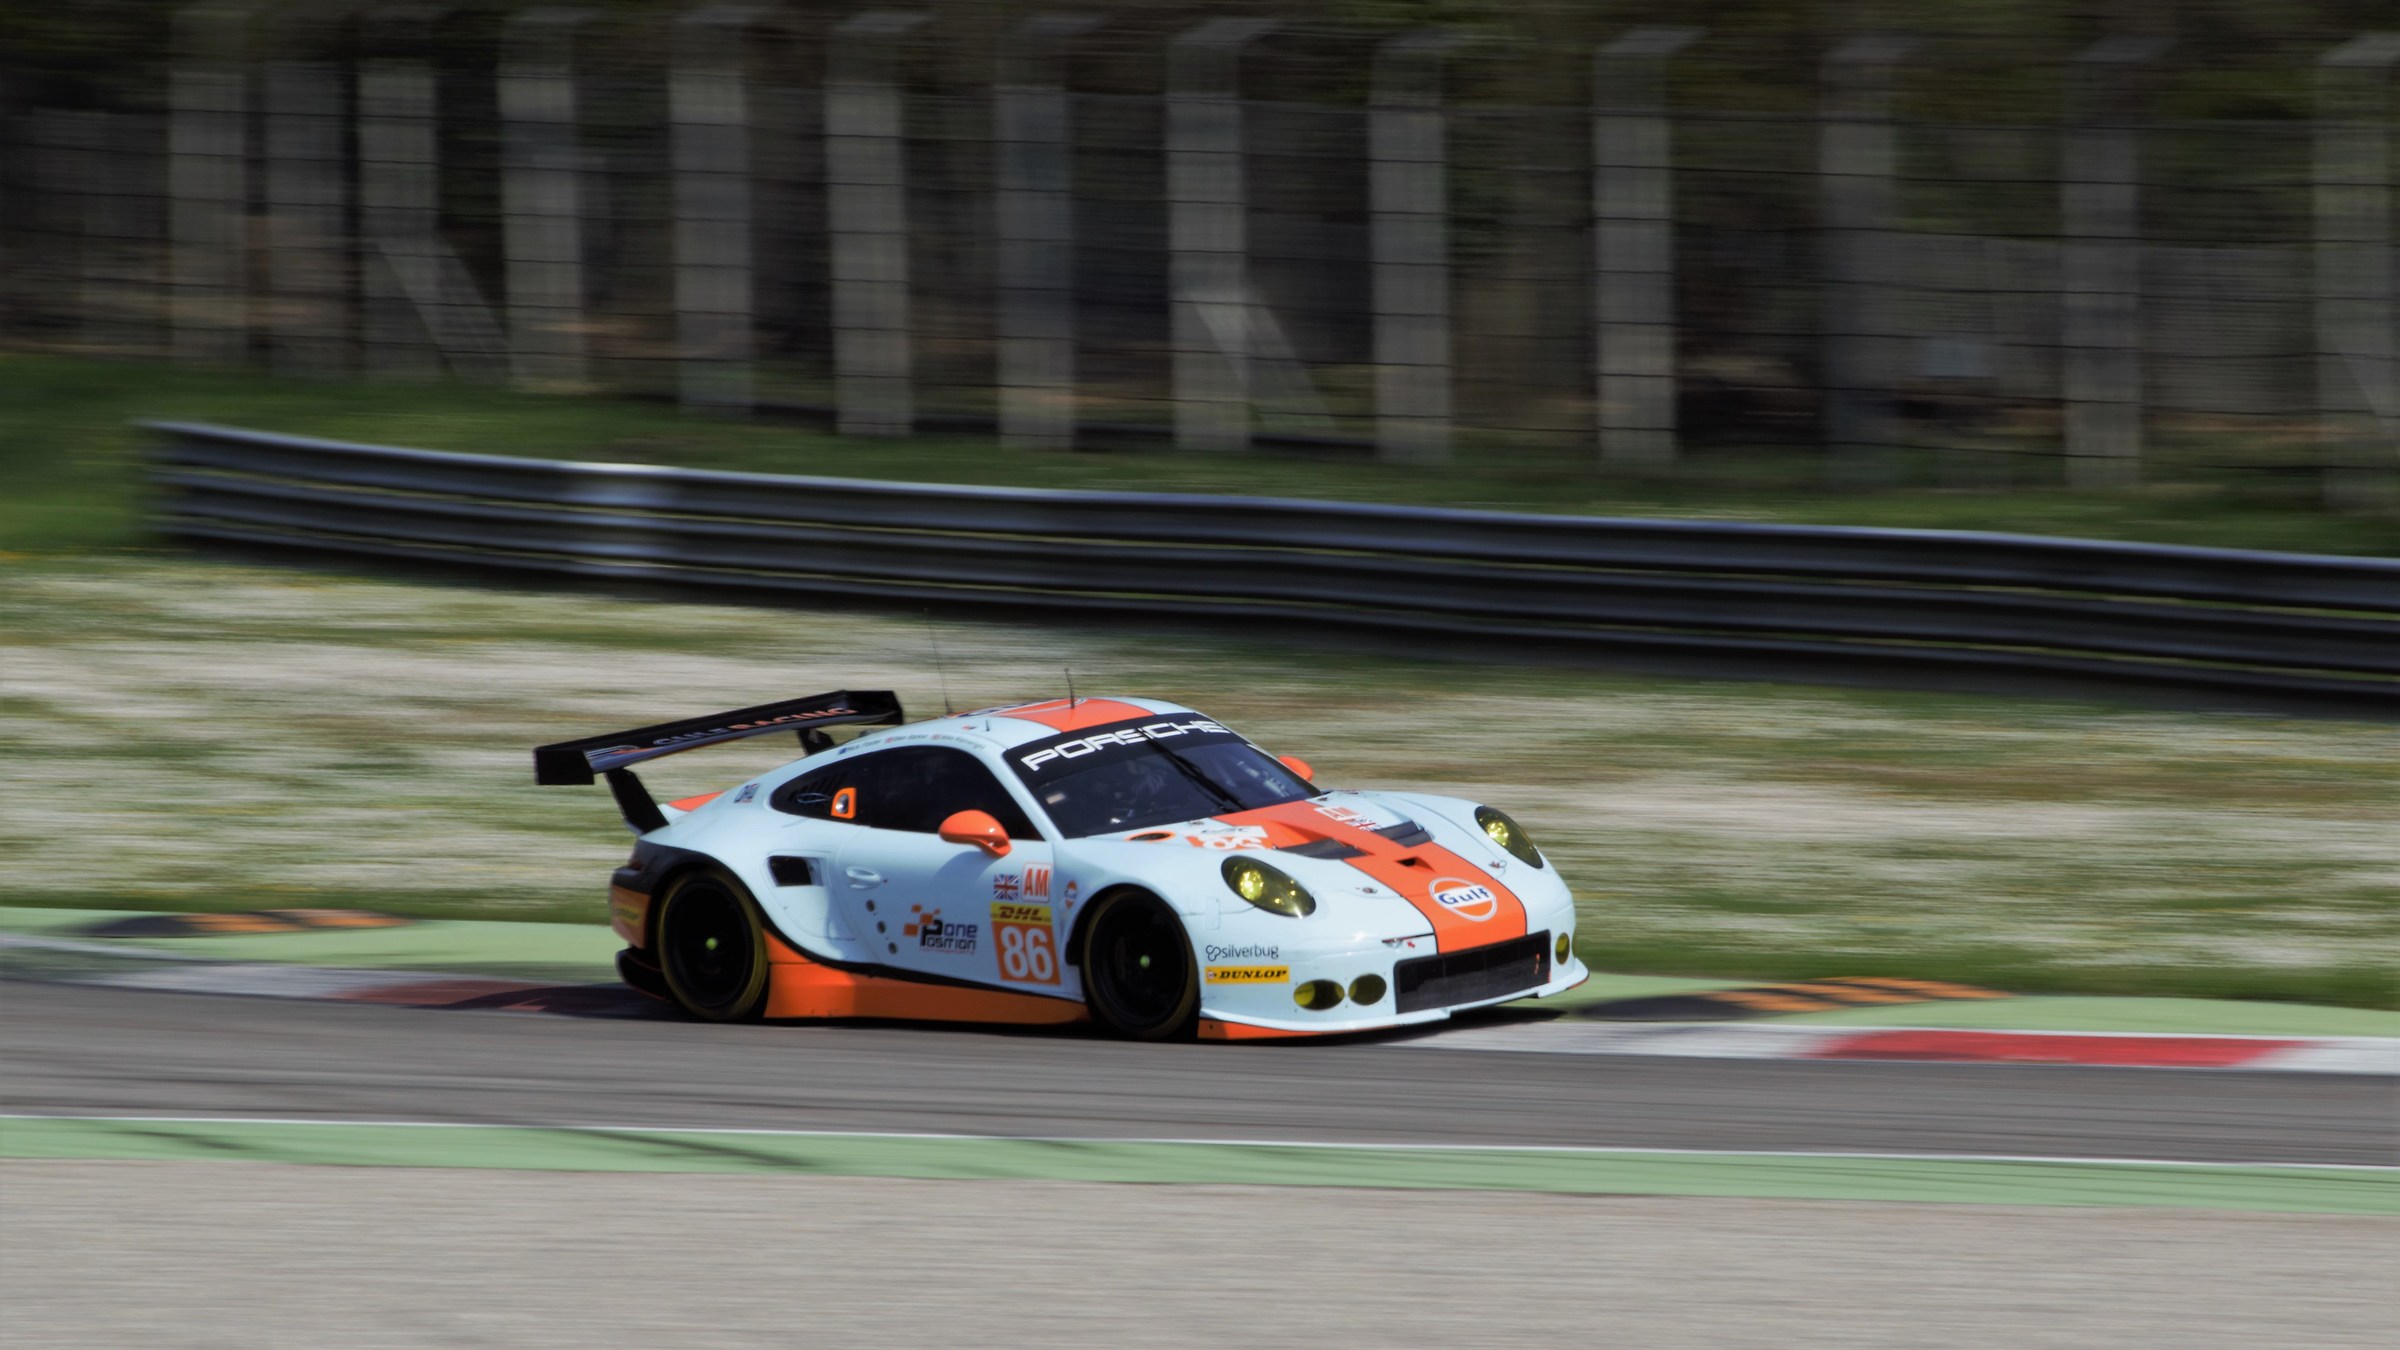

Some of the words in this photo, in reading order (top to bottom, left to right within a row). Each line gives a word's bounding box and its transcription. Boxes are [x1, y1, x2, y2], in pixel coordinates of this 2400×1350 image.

[1020, 719, 1231, 772] PORSCHE
[1023, 867, 1050, 897] AM
[1438, 887, 1490, 905] Gulf
[998, 905, 1043, 922] DHL
[1000, 925, 1054, 980] 86
[1220, 944, 1279, 960] silverbug
[1218, 969, 1287, 980] DUNLOP
